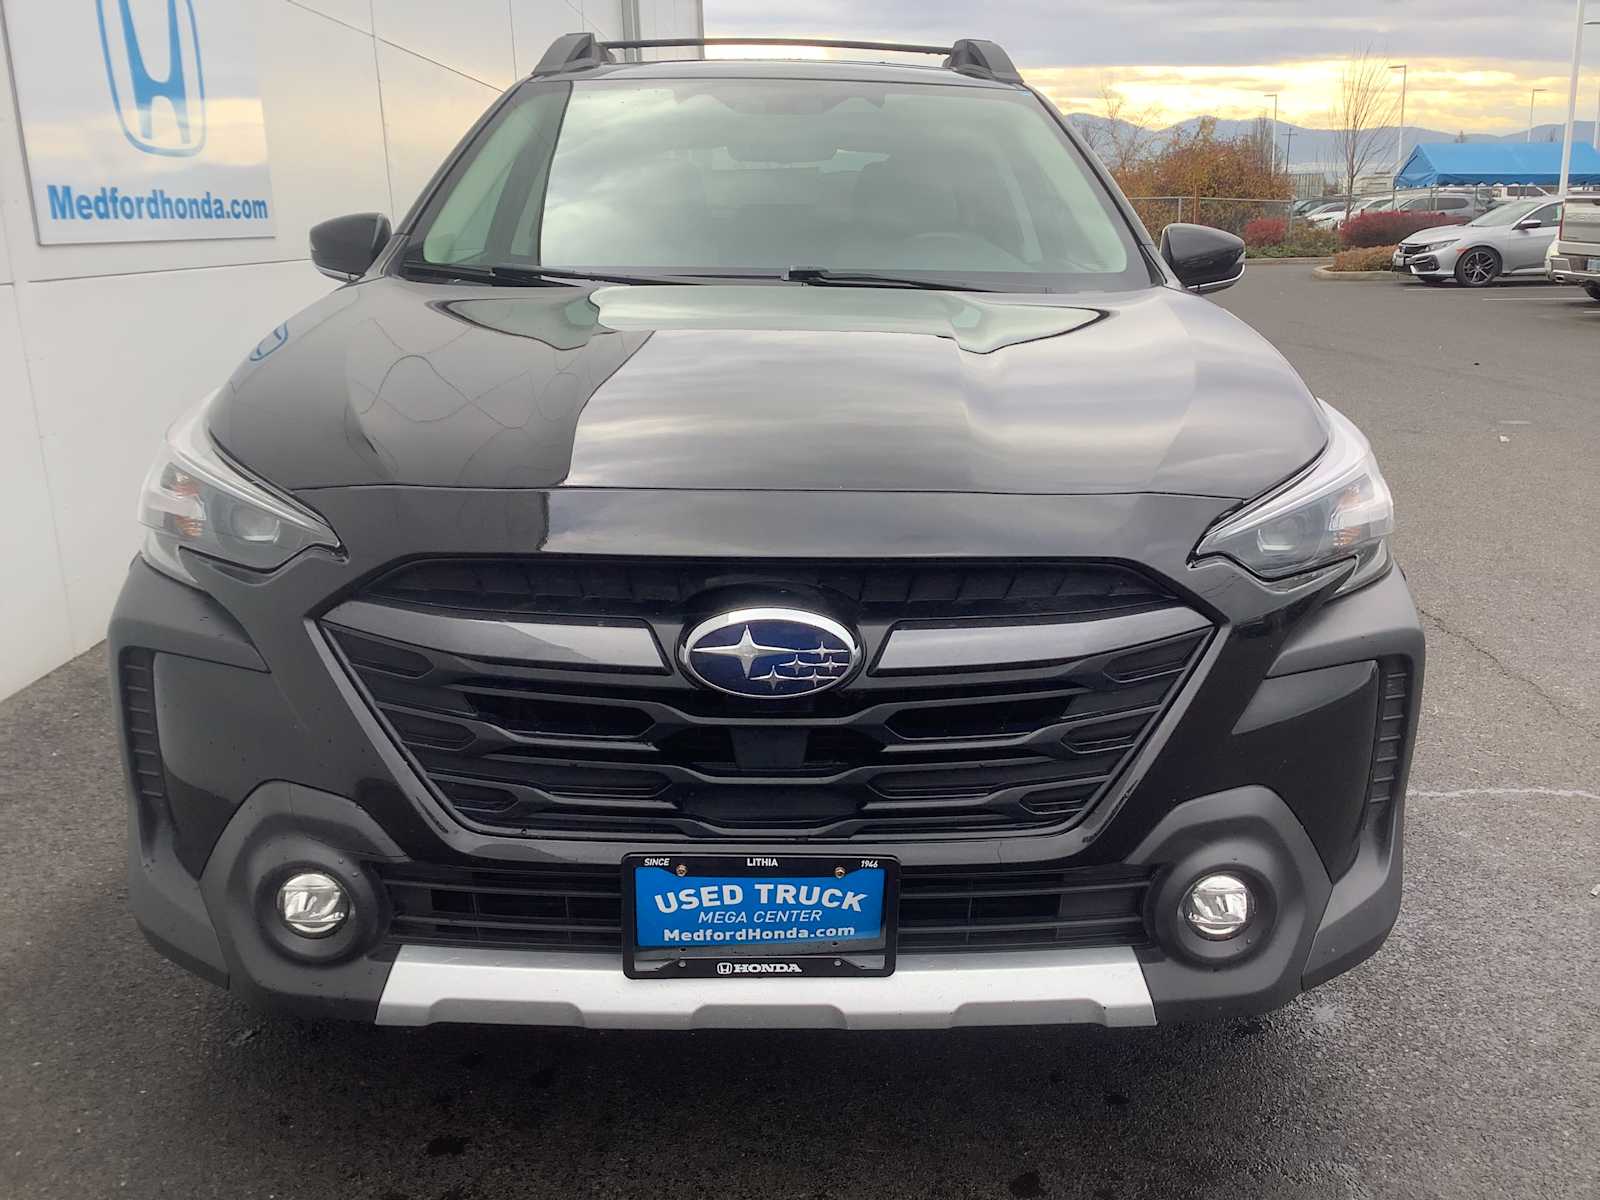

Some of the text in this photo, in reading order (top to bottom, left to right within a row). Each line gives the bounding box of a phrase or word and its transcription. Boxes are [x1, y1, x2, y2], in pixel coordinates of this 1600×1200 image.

[47, 184, 269, 221] Medfordhonda.com
[644, 857, 879, 868] SINCE LITHIA 1946
[654, 883, 869, 914] USED TRUCK
[698, 909, 823, 924] MEGA CENTER
[663, 925, 856, 942] MedfordHonda.com
[733, 963, 803, 973] HONDA
